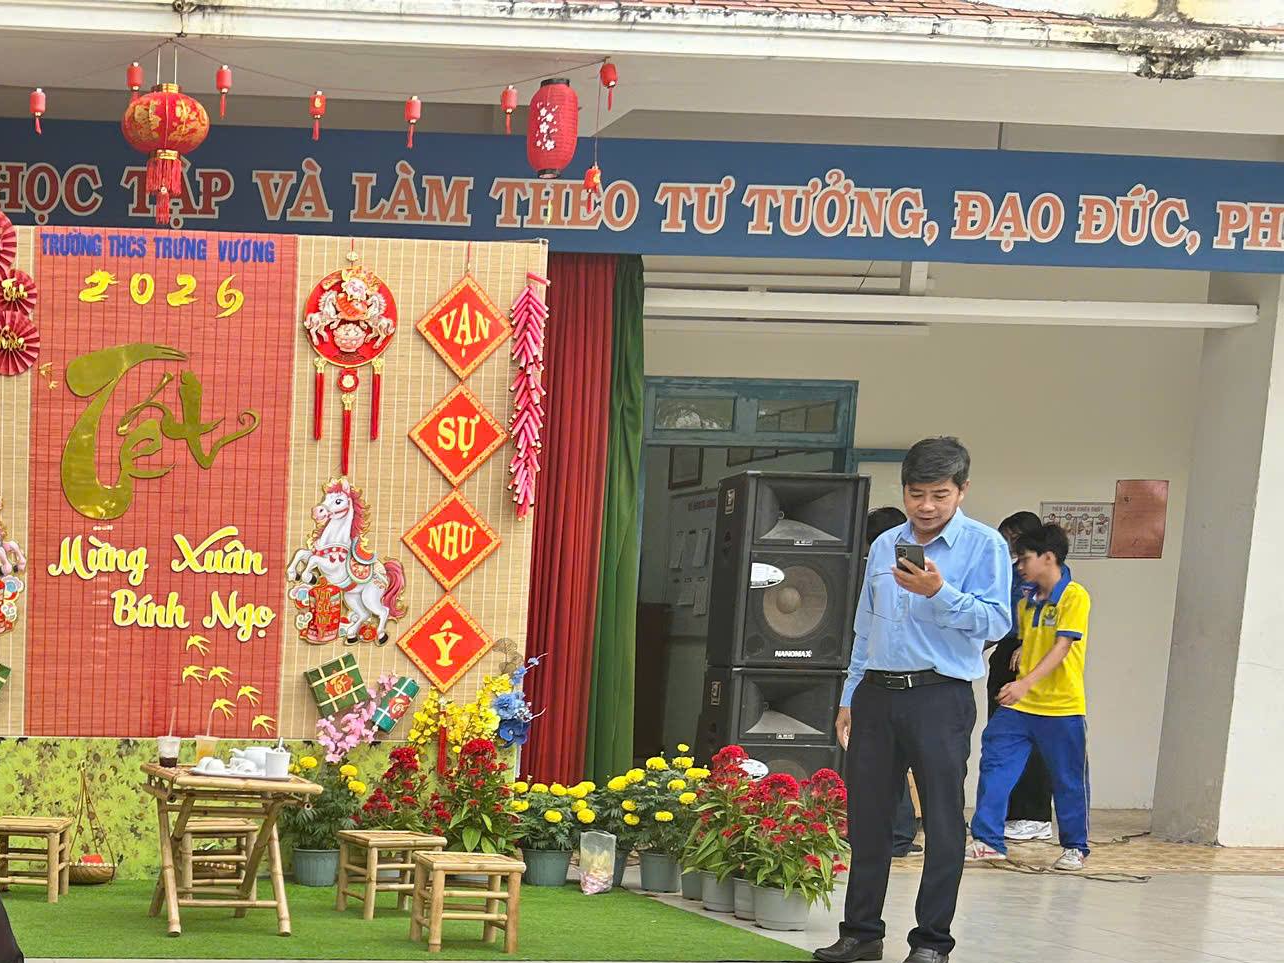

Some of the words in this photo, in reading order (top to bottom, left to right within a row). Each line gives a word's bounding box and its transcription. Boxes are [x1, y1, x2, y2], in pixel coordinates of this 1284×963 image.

[252, 156, 337, 221] VÀ
[350, 159, 473, 227] LÀM
[488, 177, 639, 232] THEO
[656, 175, 735, 235] TƯ
[742, 167, 938, 247] TƯỞNG,
[951, 189, 1065, 253] ĐẠO
[1074, 183, 1201, 256] ĐỨC,
[40, 230, 102, 257] TRƯỜNG
[108, 235, 147, 258] THCS
[218, 239, 275, 263] VƯƠNG
[78, 268, 245, 319] 2026
[438, 303, 491, 358] VẠN
[61, 342, 261, 520] Tết
[437, 415, 480, 458] SỰ
[48, 534, 149, 586] Mừng
[171, 526, 268, 576] Xuân
[427, 521, 476, 561] NHƯ
[111, 589, 190, 629] Bính
[202, 590, 276, 642] Ngọ
[429, 620, 462, 667] Ý
[774, 650, 812, 658] NANOMAX
